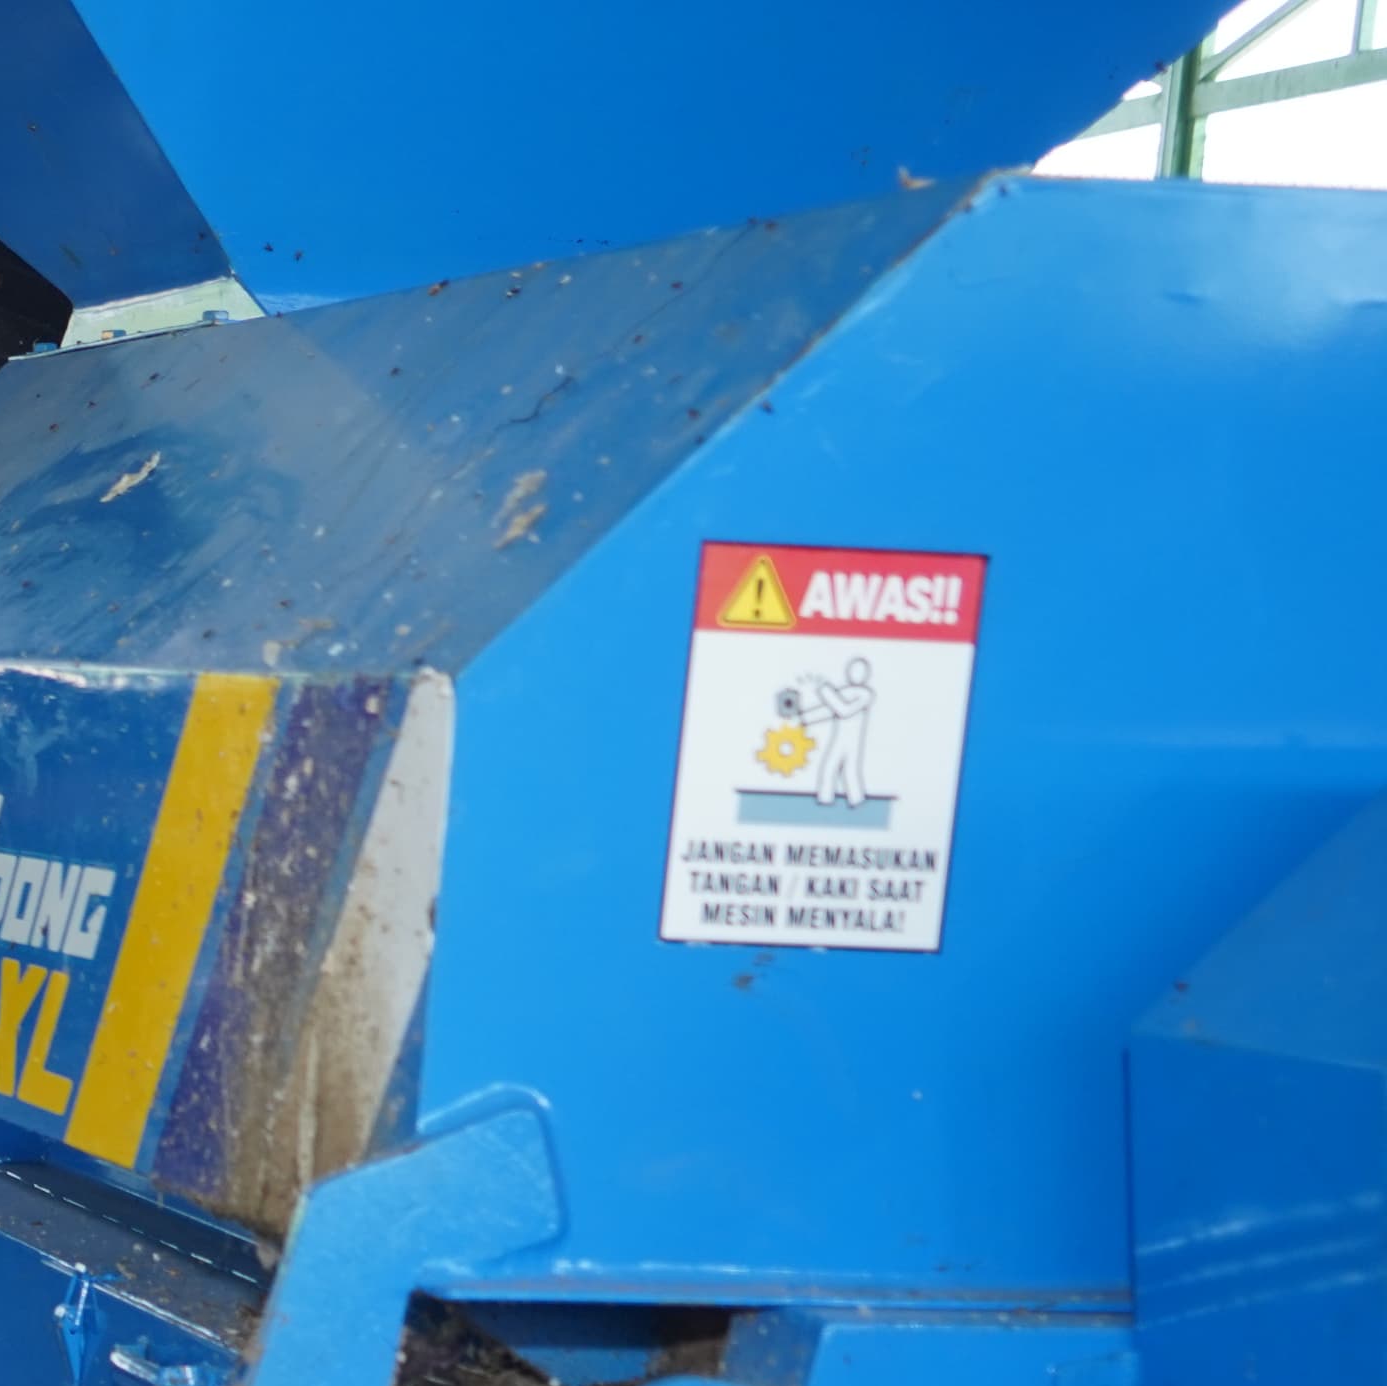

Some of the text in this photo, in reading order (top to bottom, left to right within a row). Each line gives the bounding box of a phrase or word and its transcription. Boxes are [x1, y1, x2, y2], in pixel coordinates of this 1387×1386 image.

[799, 570, 962, 625] AWAS!!
[681, 840, 936, 872] JANGAN MEMASUKAN
[690, 871, 780, 896] TANGAN
[805, 876, 859, 898] KAKI
[868, 879, 926, 901] SAAT
[702, 903, 906, 932] MESIN MENYALA!
